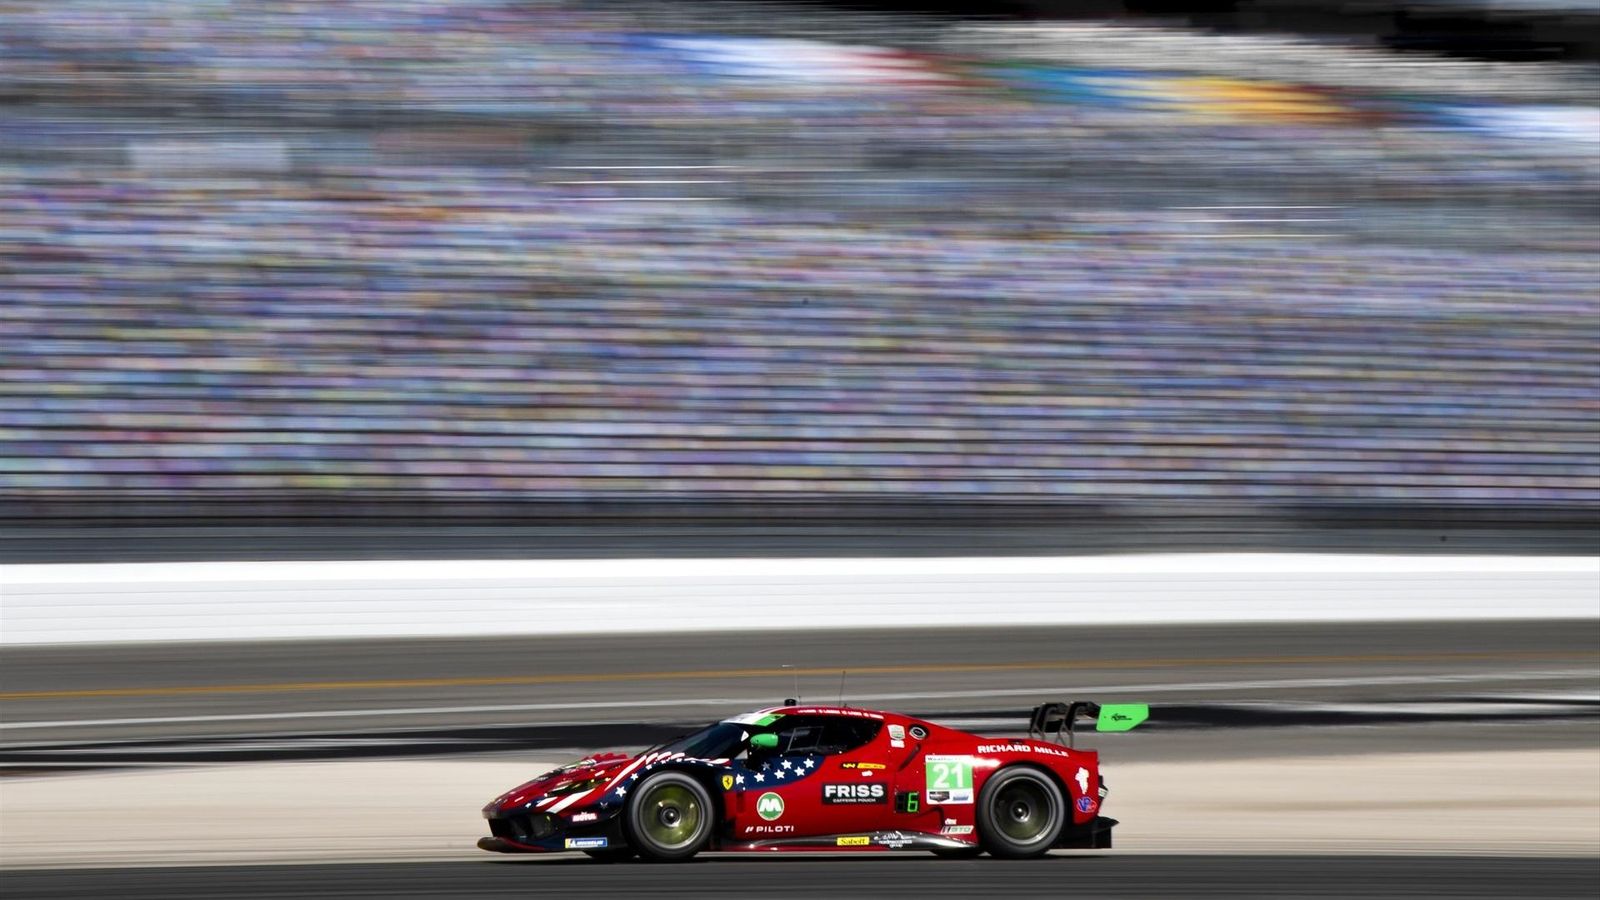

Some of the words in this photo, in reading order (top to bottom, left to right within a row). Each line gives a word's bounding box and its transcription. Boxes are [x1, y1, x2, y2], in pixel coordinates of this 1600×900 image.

[977, 744, 1031, 754] RICHARD
[1034, 746, 1069, 757] MILLE
[932, 762, 964, 789] 21
[825, 784, 884, 798] FRISS
[907, 792, 918, 812] 6
[755, 825, 795, 833] PILOTI
